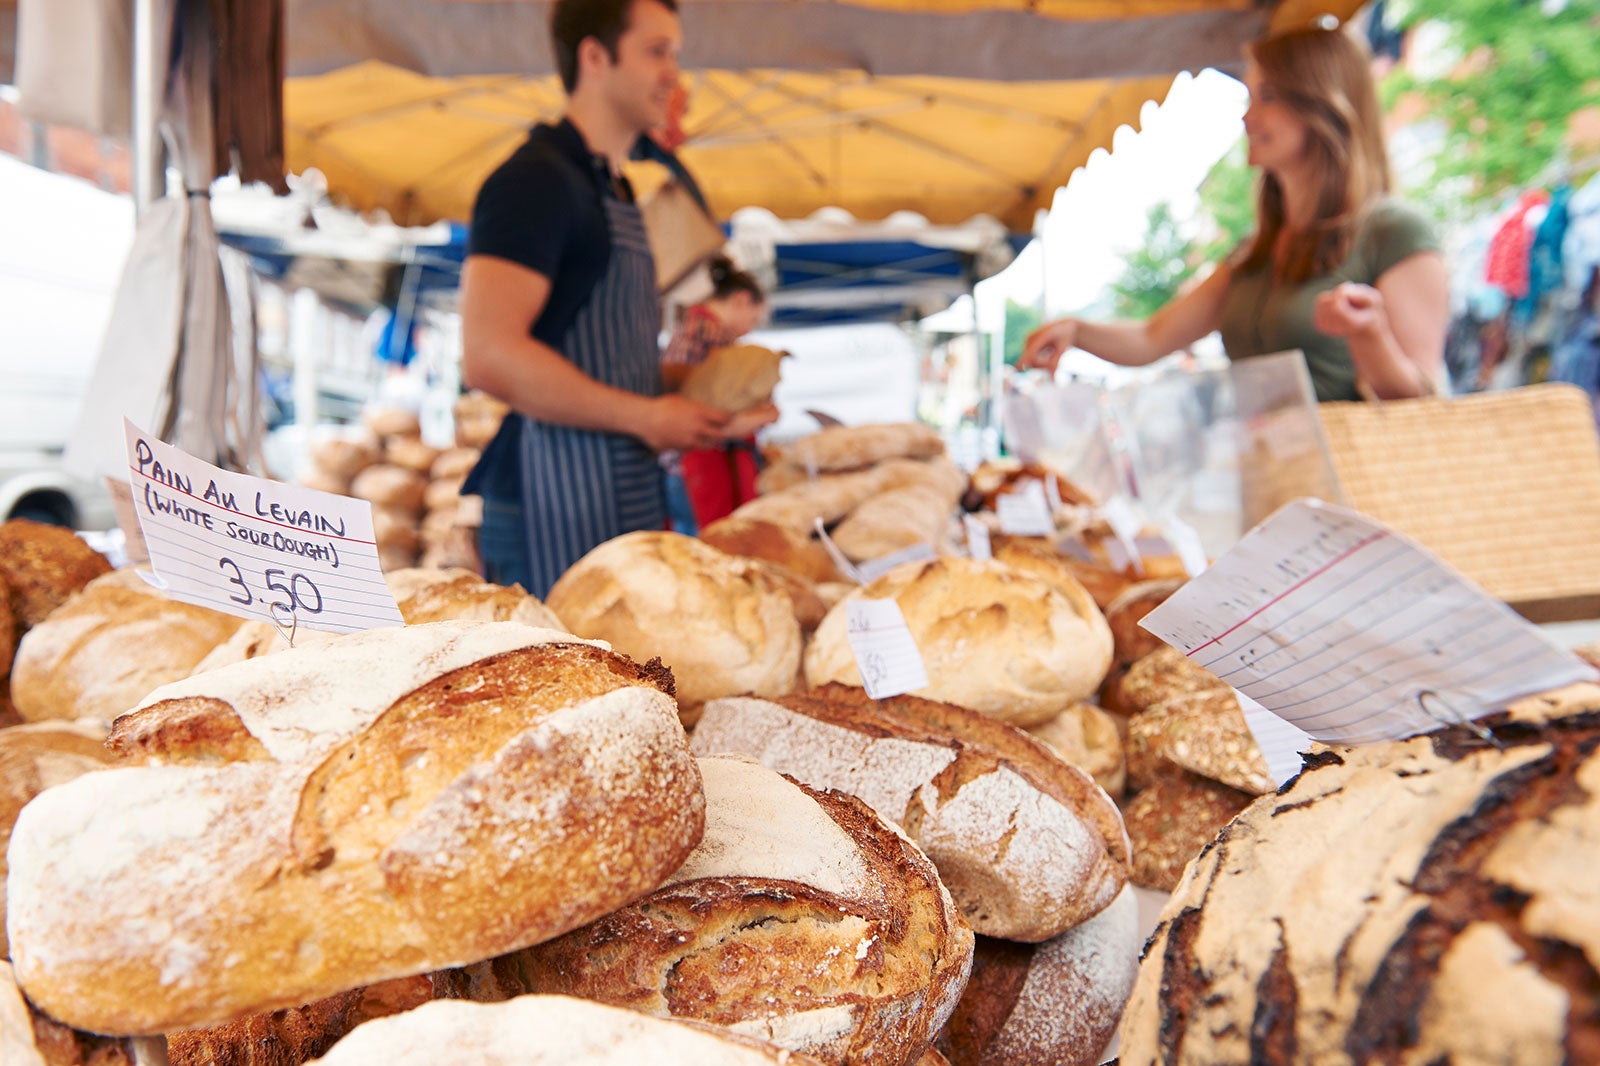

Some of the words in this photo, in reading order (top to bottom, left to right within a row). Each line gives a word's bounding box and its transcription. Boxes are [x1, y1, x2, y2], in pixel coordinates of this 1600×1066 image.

[136, 438, 192, 495] PAIN
[256, 492, 345, 537] LEVAIN
[226, 521, 339, 568] SOURDOUGH)
[219, 557, 322, 614] 3.50
